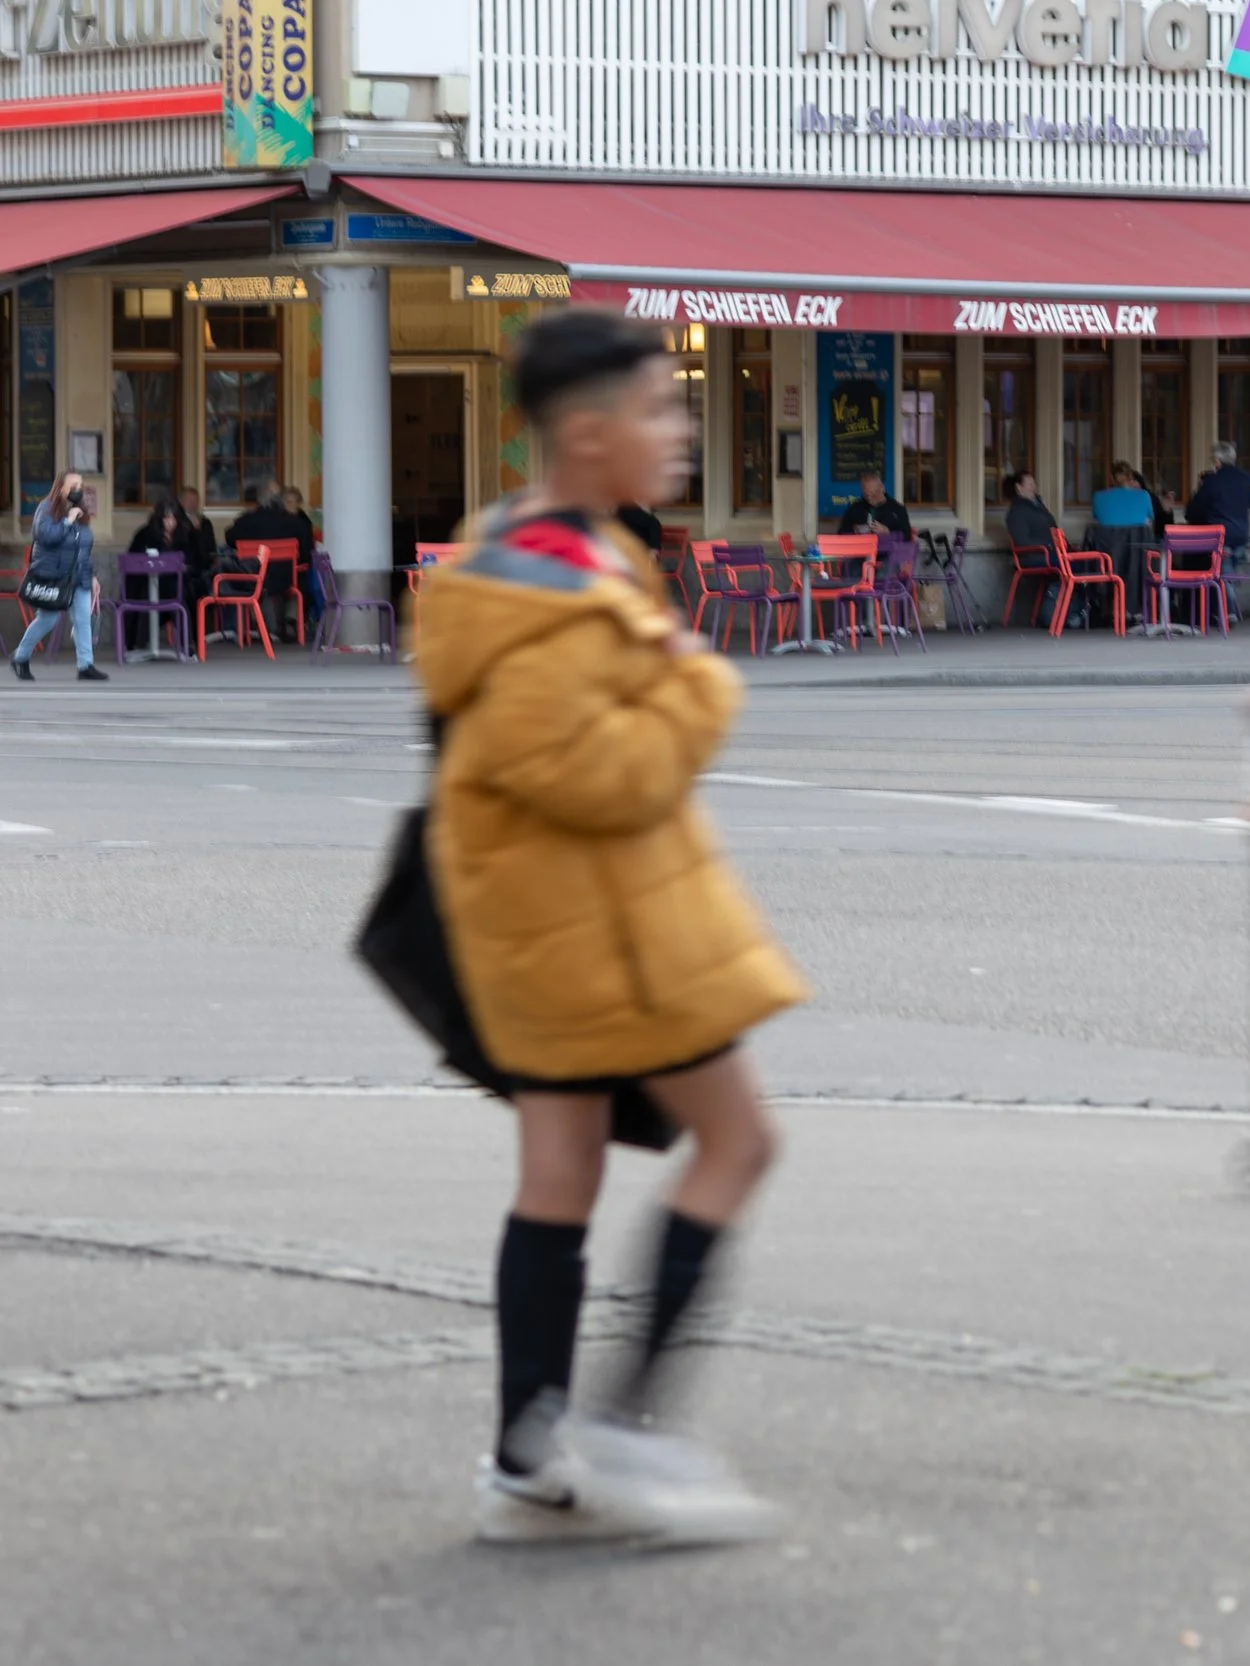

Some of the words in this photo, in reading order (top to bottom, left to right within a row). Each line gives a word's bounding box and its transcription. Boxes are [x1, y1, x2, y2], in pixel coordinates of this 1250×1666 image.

[282, 0, 306, 101] COPA
[261, 15, 275, 129] DANCING
[798, 102, 857, 134] Ihre
[866, 105, 1014, 142] Schweizer
[491, 273, 533, 297] ZUM
[625, 287, 681, 320] ZUM
[681, 289, 793, 325] SCHIEFEN
[794, 294, 843, 327] ECK
[954, 300, 1007, 332] ZUM
[1008, 302, 1114, 334] SCHIEFEN
[1114, 304, 1159, 335] ECK
